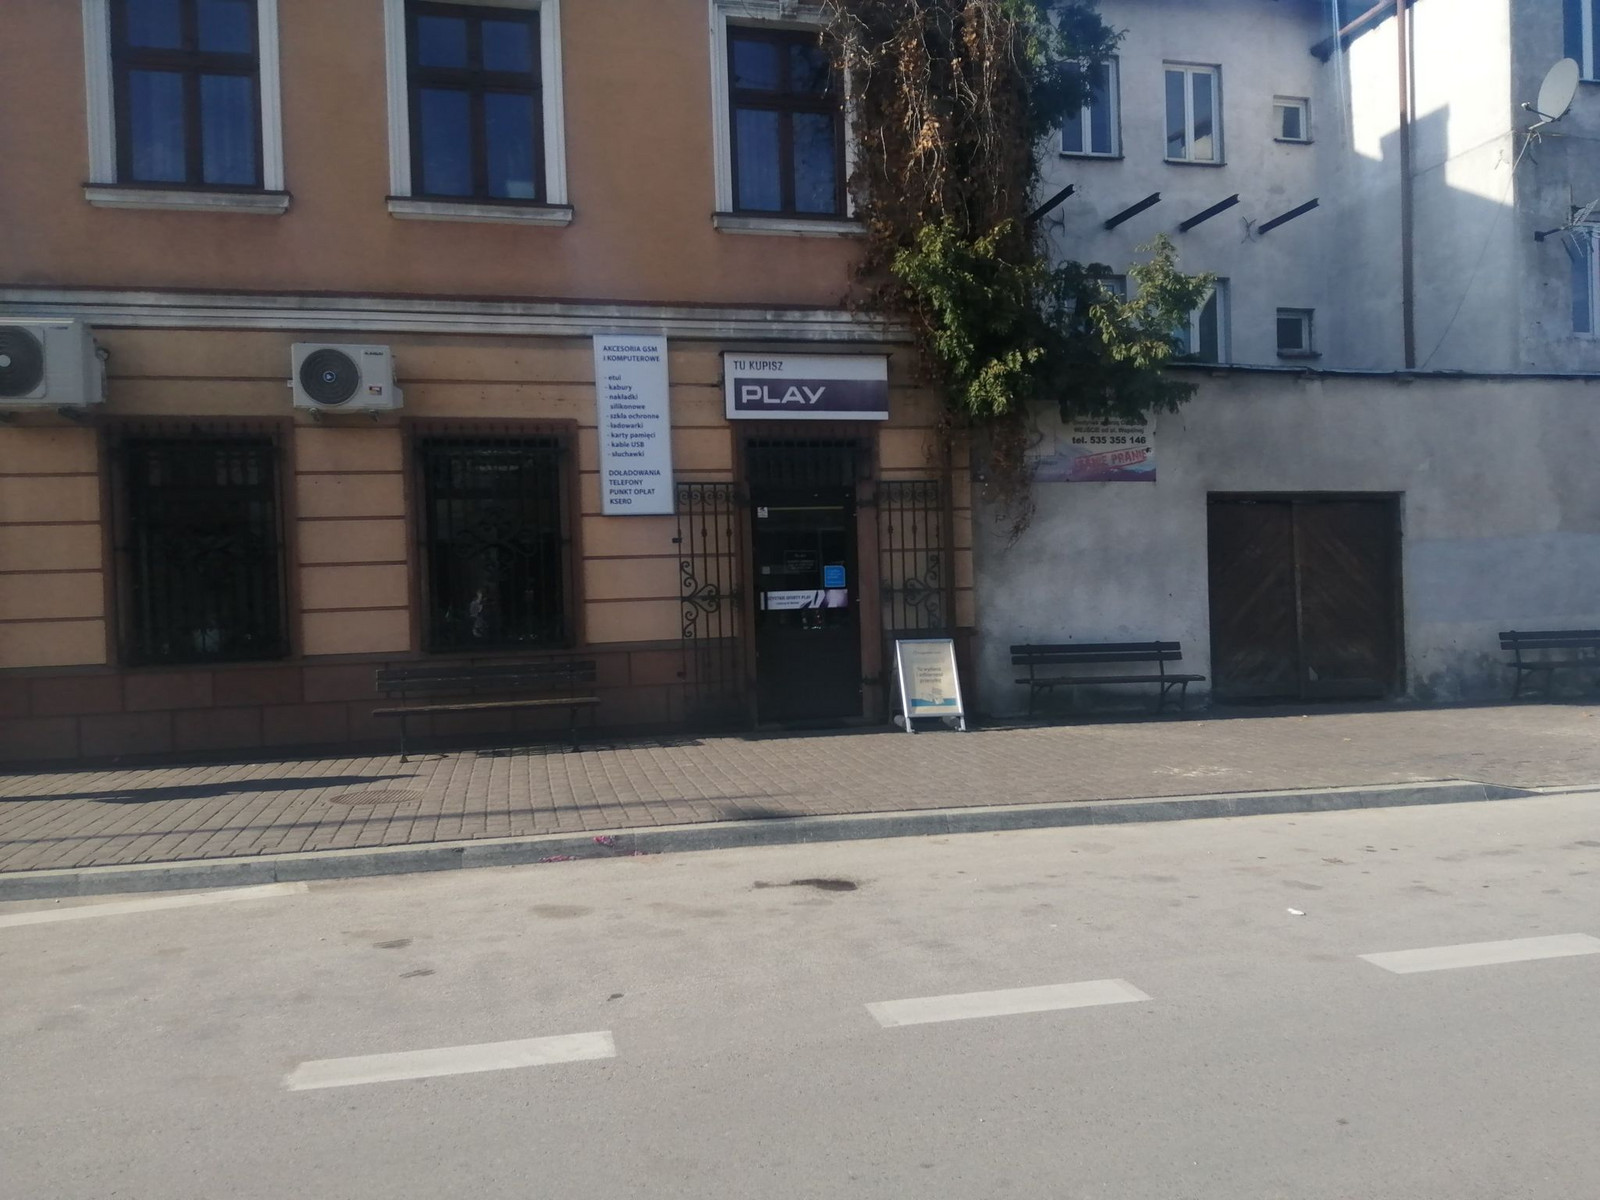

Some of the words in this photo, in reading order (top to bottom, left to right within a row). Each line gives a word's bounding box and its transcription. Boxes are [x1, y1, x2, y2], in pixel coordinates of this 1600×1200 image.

[733, 360, 746, 371] TU
[749, 360, 784, 372] KUPISZ
[608, 384, 632, 392] kabury
[741, 385, 827, 404] PLAY
[1072, 436, 1088, 445] tel.
[1090, 436, 1107, 445] 535
[1109, 436, 1127, 445] 355
[1130, 436, 1146, 445] 146
[609, 488, 632, 496] PUNKT
